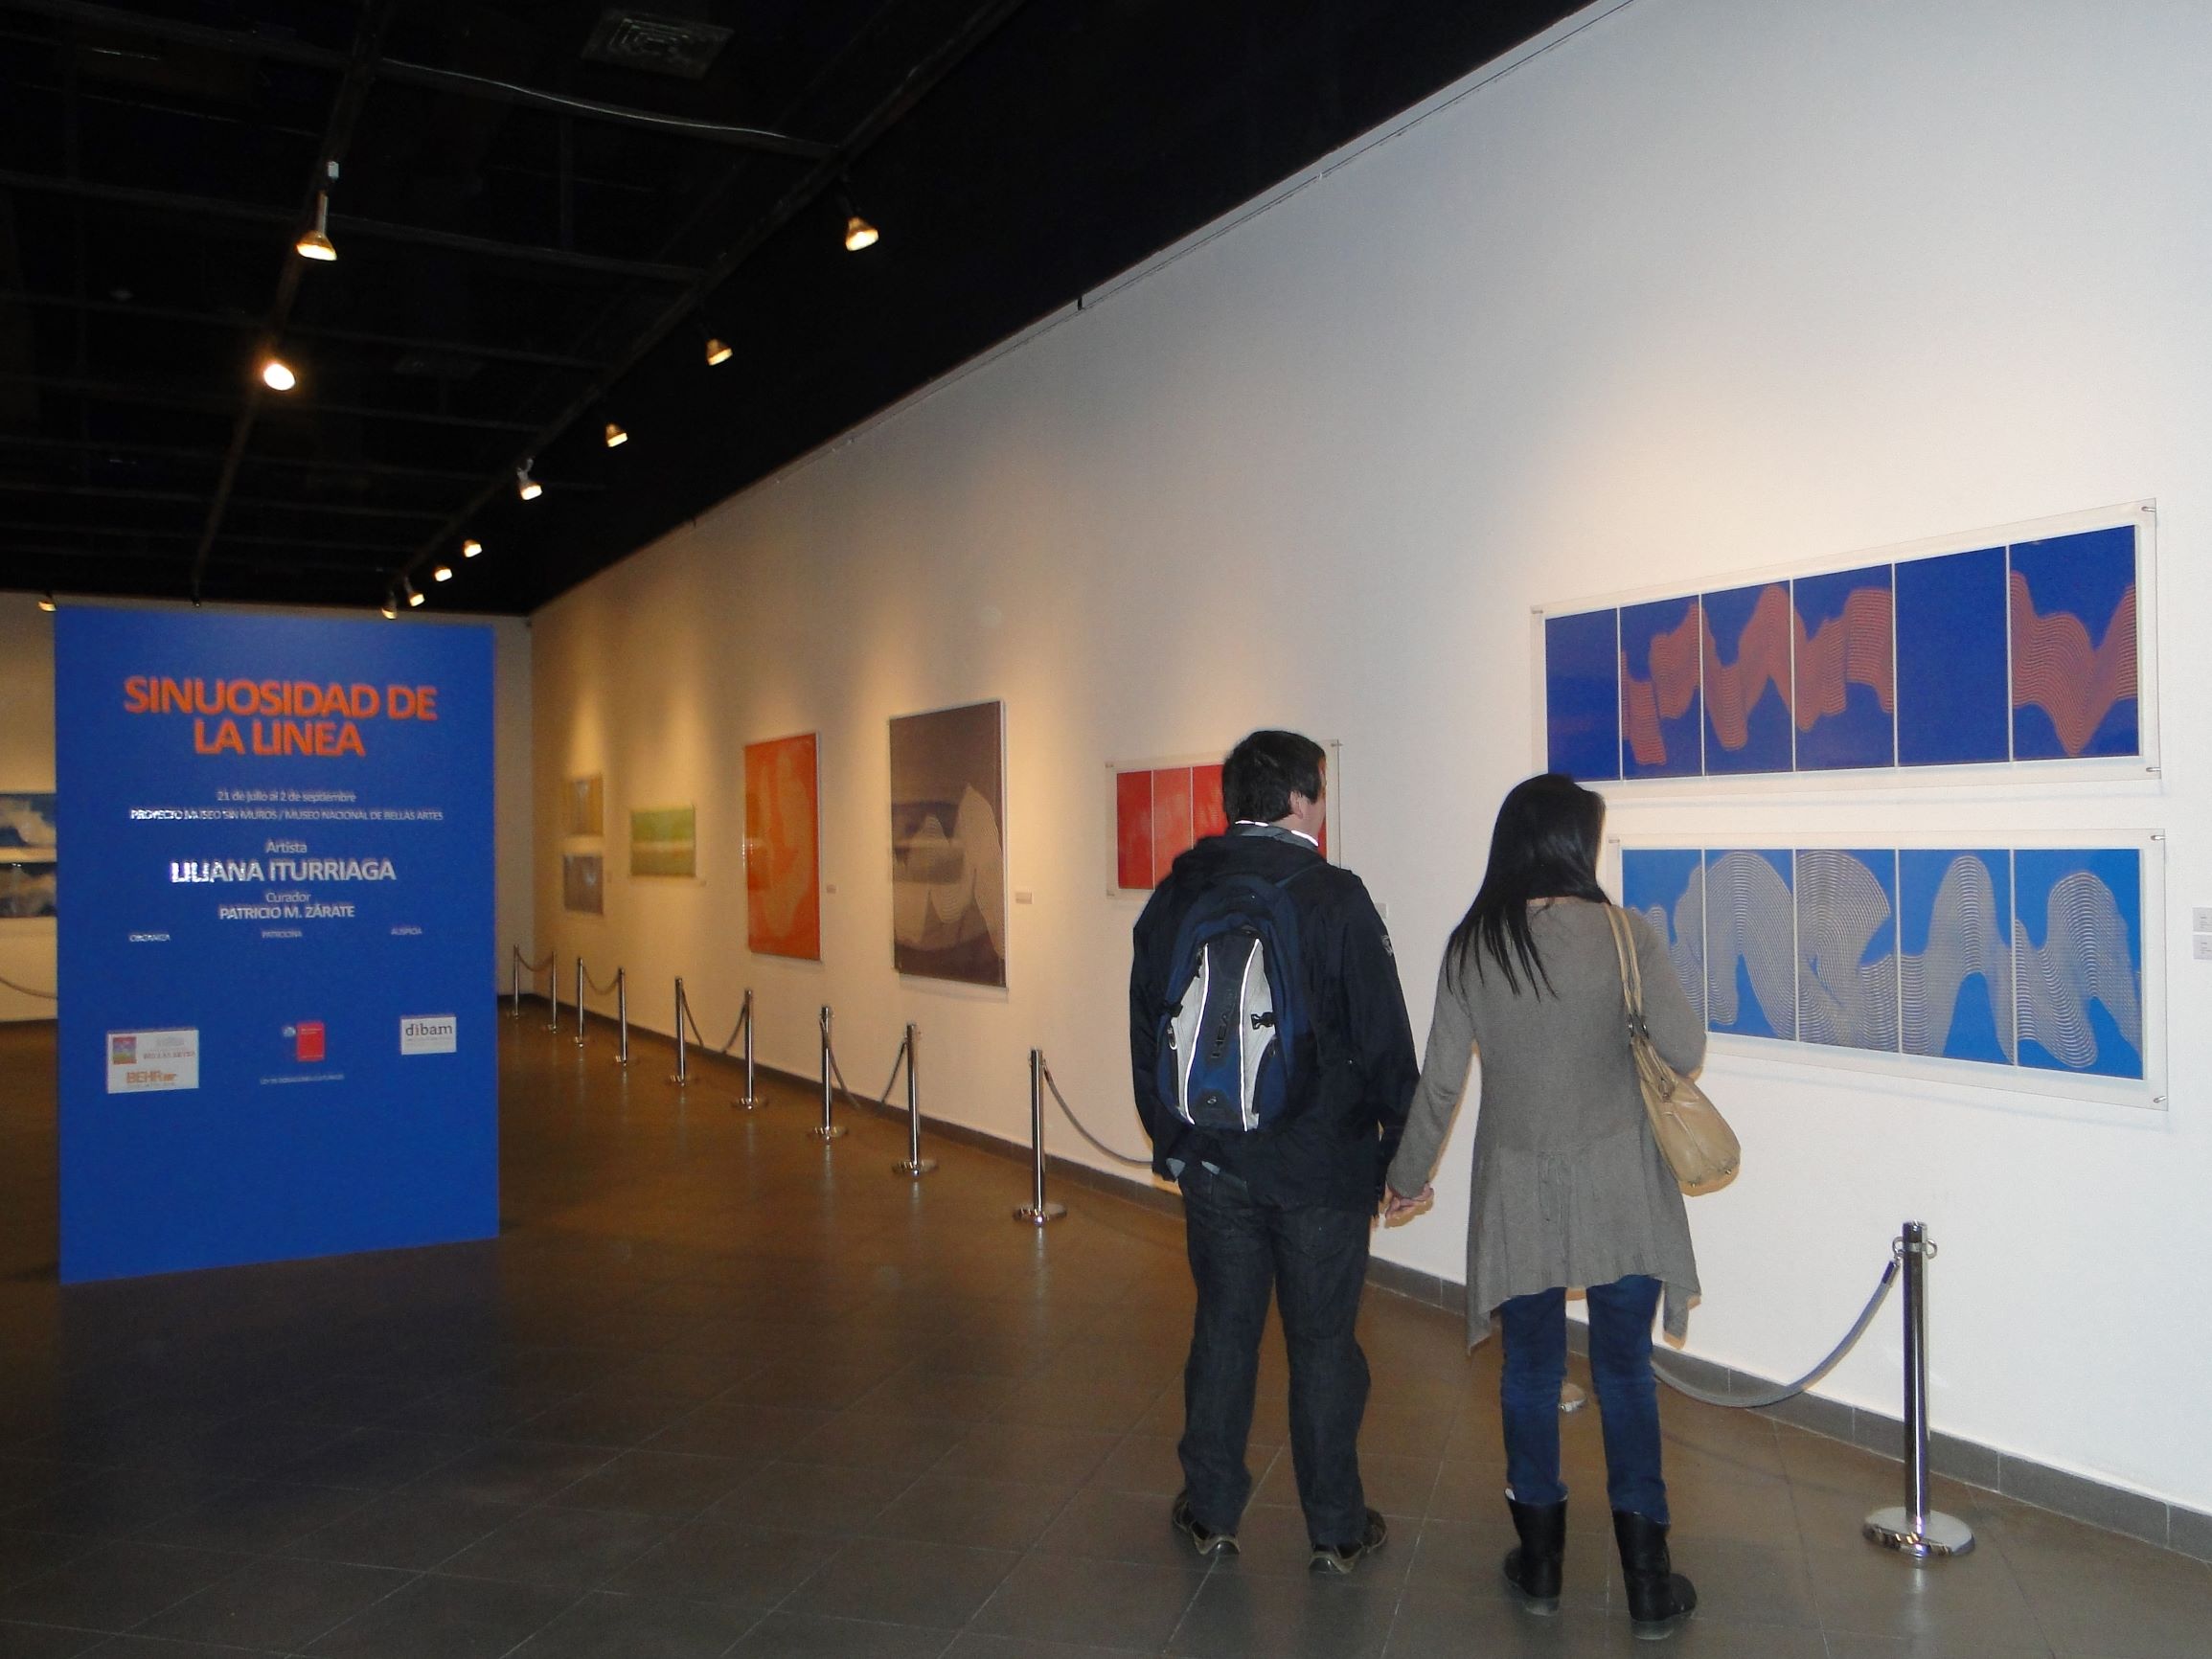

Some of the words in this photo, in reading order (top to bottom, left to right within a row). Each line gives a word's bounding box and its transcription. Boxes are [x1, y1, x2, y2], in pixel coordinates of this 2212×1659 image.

[124, 676, 380, 717] SINUOSIDAD
[387, 684, 438, 720] DE
[194, 718, 245, 755] LA
[252, 720, 365, 756] LINEA
[217, 789, 230, 801] 21
[232, 789, 244, 801] de
[245, 789, 268, 803] julio
[269, 790, 279, 802] al
[280, 790, 286, 801] 2
[288, 790, 302, 802] de
[303, 790, 356, 803] septiembre
[130, 808, 183, 820] PROYECTO
[184, 808, 221, 820] MUSEO
[240, 809, 277, 820] MUROS
[285, 809, 319, 820] MUSEO
[321, 809, 368, 821] NACIONAL
[370, 809, 382, 821] DE
[384, 810, 415, 821] BELLAS
[417, 810, 444, 821] ARTES
[265, 841, 308, 853] Artista
[171, 860, 265, 883] LILIANA
[269, 859, 397, 881] ITURRIAGA
[265, 891, 311, 903] Curador
[218, 907, 282, 920] PATRICIO
[284, 907, 303, 919] M.
[305, 903, 355, 919] ZÁRATE
[405, 1023, 453, 1036] dibam
